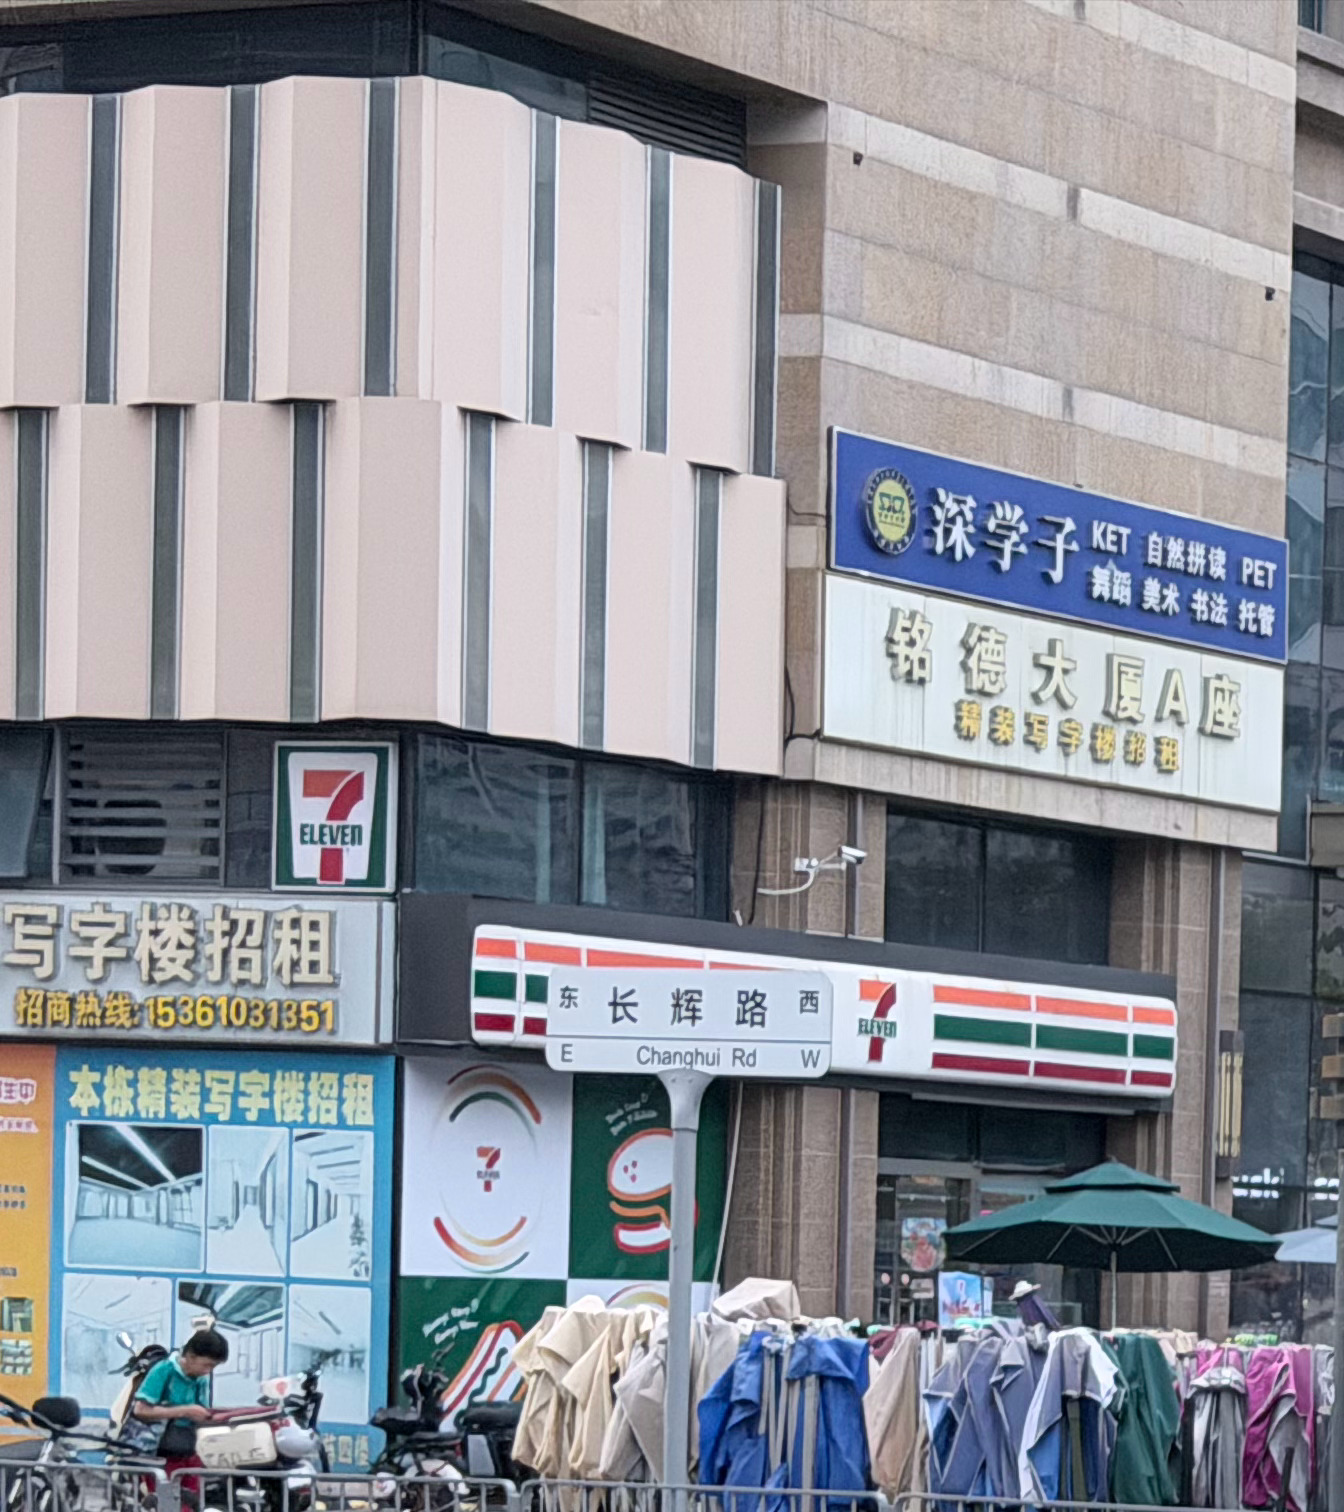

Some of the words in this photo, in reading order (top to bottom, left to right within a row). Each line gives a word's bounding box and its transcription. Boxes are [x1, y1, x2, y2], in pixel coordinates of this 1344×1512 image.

[930, 487, 1081, 584] 深学子
[1092, 521, 1131, 555] KET
[1147, 532, 1227, 581] 自然拼读
[1242, 557, 1277, 590] PET
[1143, 578, 1180, 615] 美术
[1192, 589, 1228, 626] 书法
[1239, 600, 1275, 637] 托管
[885, 607, 1241, 739] 铭德大厦A座
[956, 699, 1180, 773] 精装写字楼招租
[2, 902, 336, 986] 写字楼招租
[559, 986, 579, 1009] 东
[608, 988, 768, 1029] 长辉路
[799, 990, 820, 1015] 西
[562, 1044, 573, 1064] E
[636, 1043, 722, 1070] Changhui
[732, 1046, 758, 1068] Rd
[801, 1048, 821, 1069] W
[68, 1065, 376, 1126] 本栋精装写字楼招租
